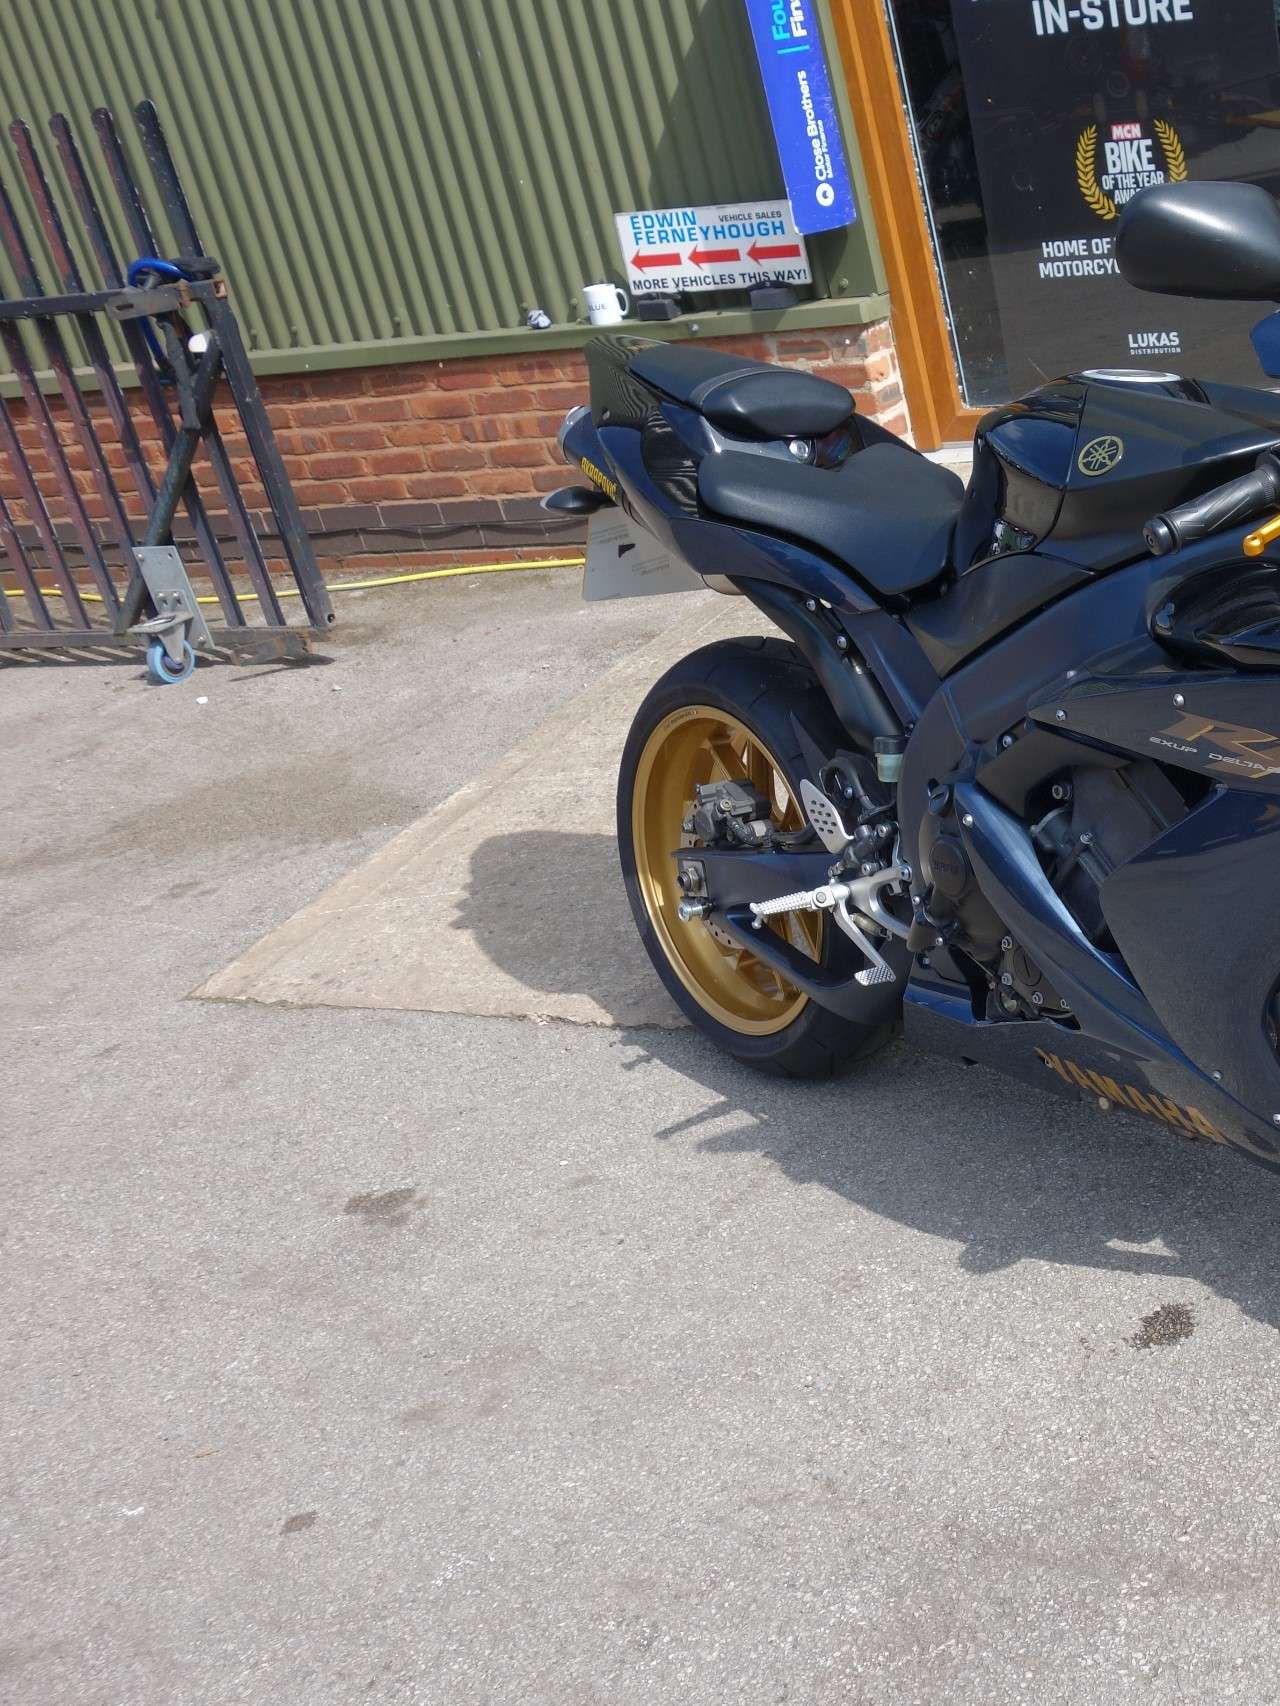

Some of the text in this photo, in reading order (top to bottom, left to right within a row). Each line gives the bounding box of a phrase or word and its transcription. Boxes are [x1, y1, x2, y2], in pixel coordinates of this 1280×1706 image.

[1031, 0, 1194, 36] IN-STORE
[797, 69, 827, 181] Close Brothers
[1112, 123, 1142, 140] MCN
[817, 119, 829, 153] Finance
[1104, 138, 1156, 174] BIKE
[1101, 170, 1165, 190] OF THE YEAR
[630, 210, 697, 231] EDWIN
[718, 210, 782, 223] VEHICLE SALES
[633, 220, 786, 246] FERNEYHOUGH
[1041, 237, 1112, 258] HOME OF
[632, 269, 808, 291] MORE VEHICLES THIS WAY!
[1127, 331, 1180, 348] LUKAS
[1130, 347, 1181, 355] DISTRIBUTION
[1149, 736, 1198, 753] EXUP
